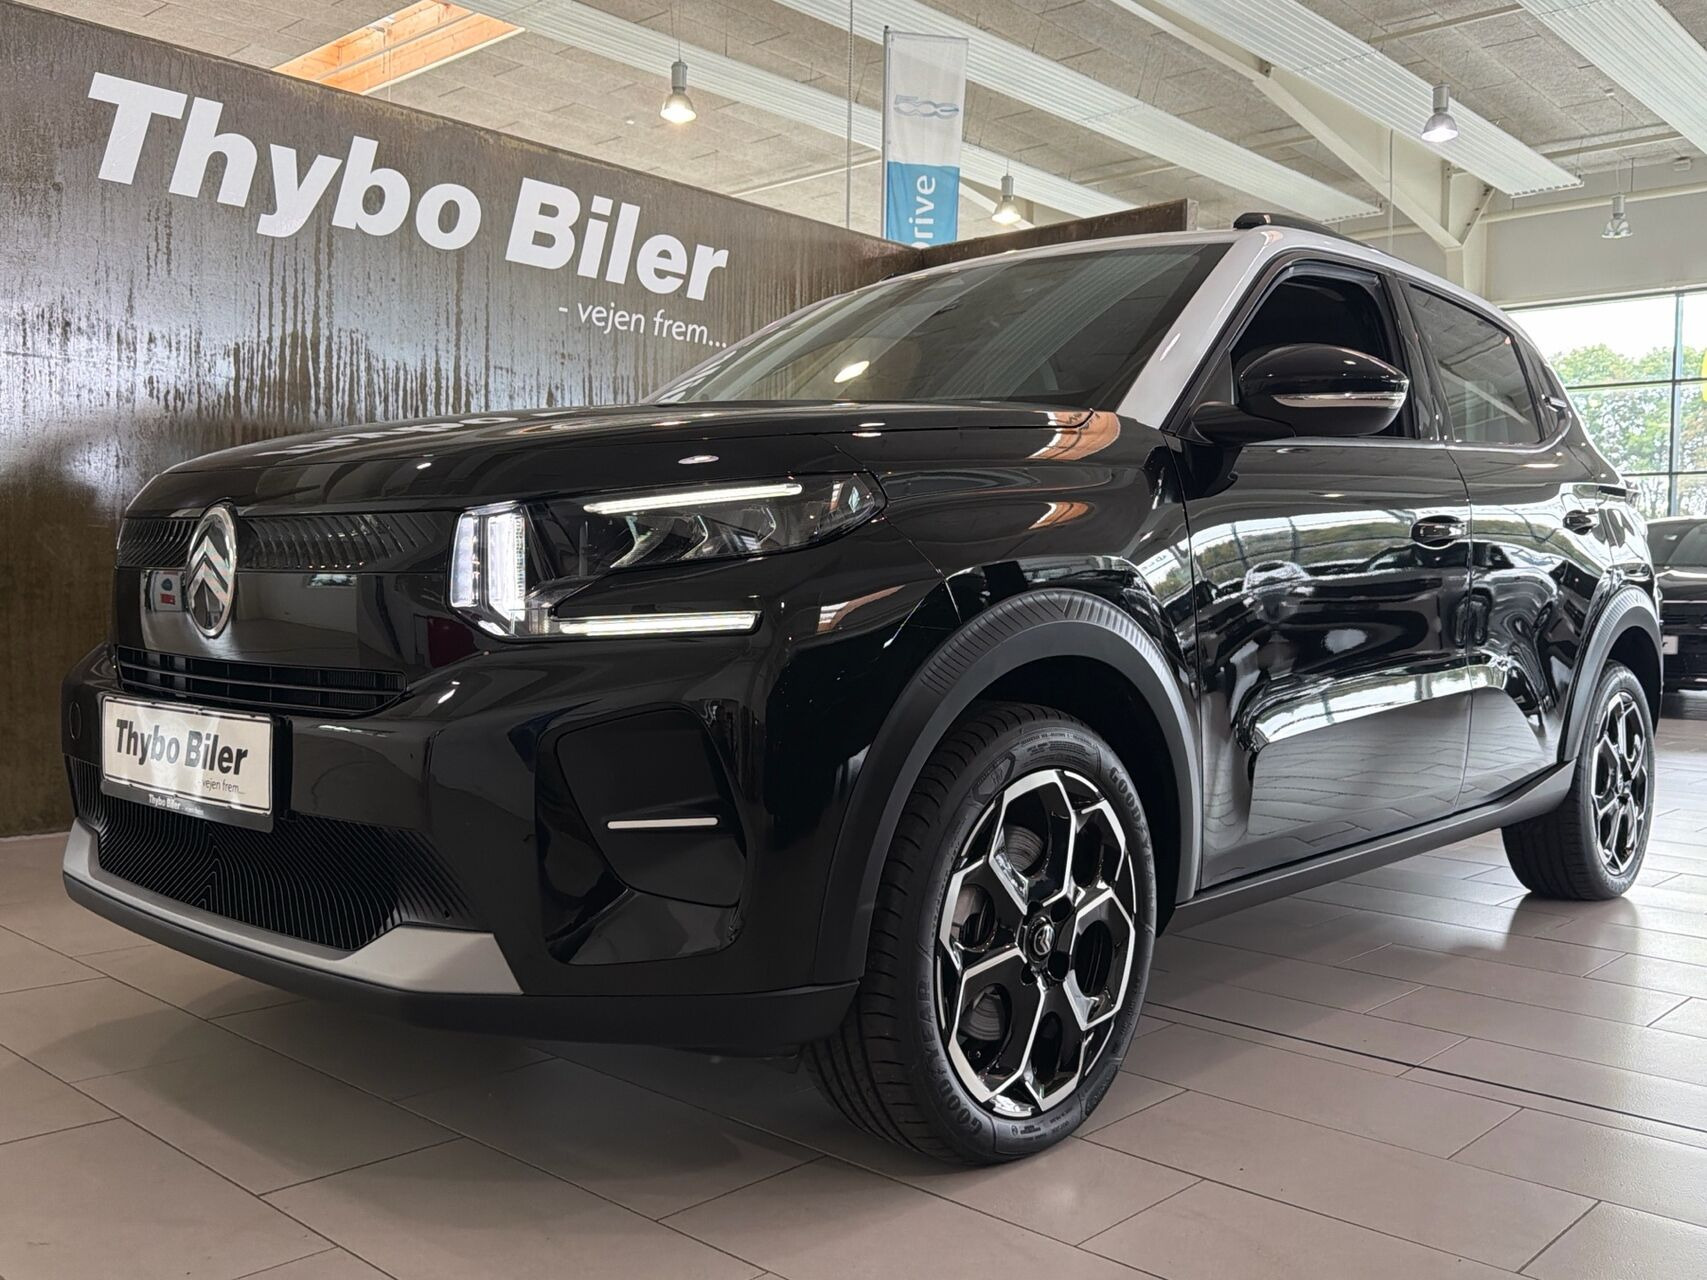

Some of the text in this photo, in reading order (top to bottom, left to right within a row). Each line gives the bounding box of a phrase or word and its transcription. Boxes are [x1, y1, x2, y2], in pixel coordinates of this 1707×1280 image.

[87, 72, 729, 301] Thybo Biler
[909, 175, 936, 247] rive
[577, 303, 645, 335] vejen
[653, 308, 728, 348] frem...
[116, 719, 248, 775] Thybo Biler
